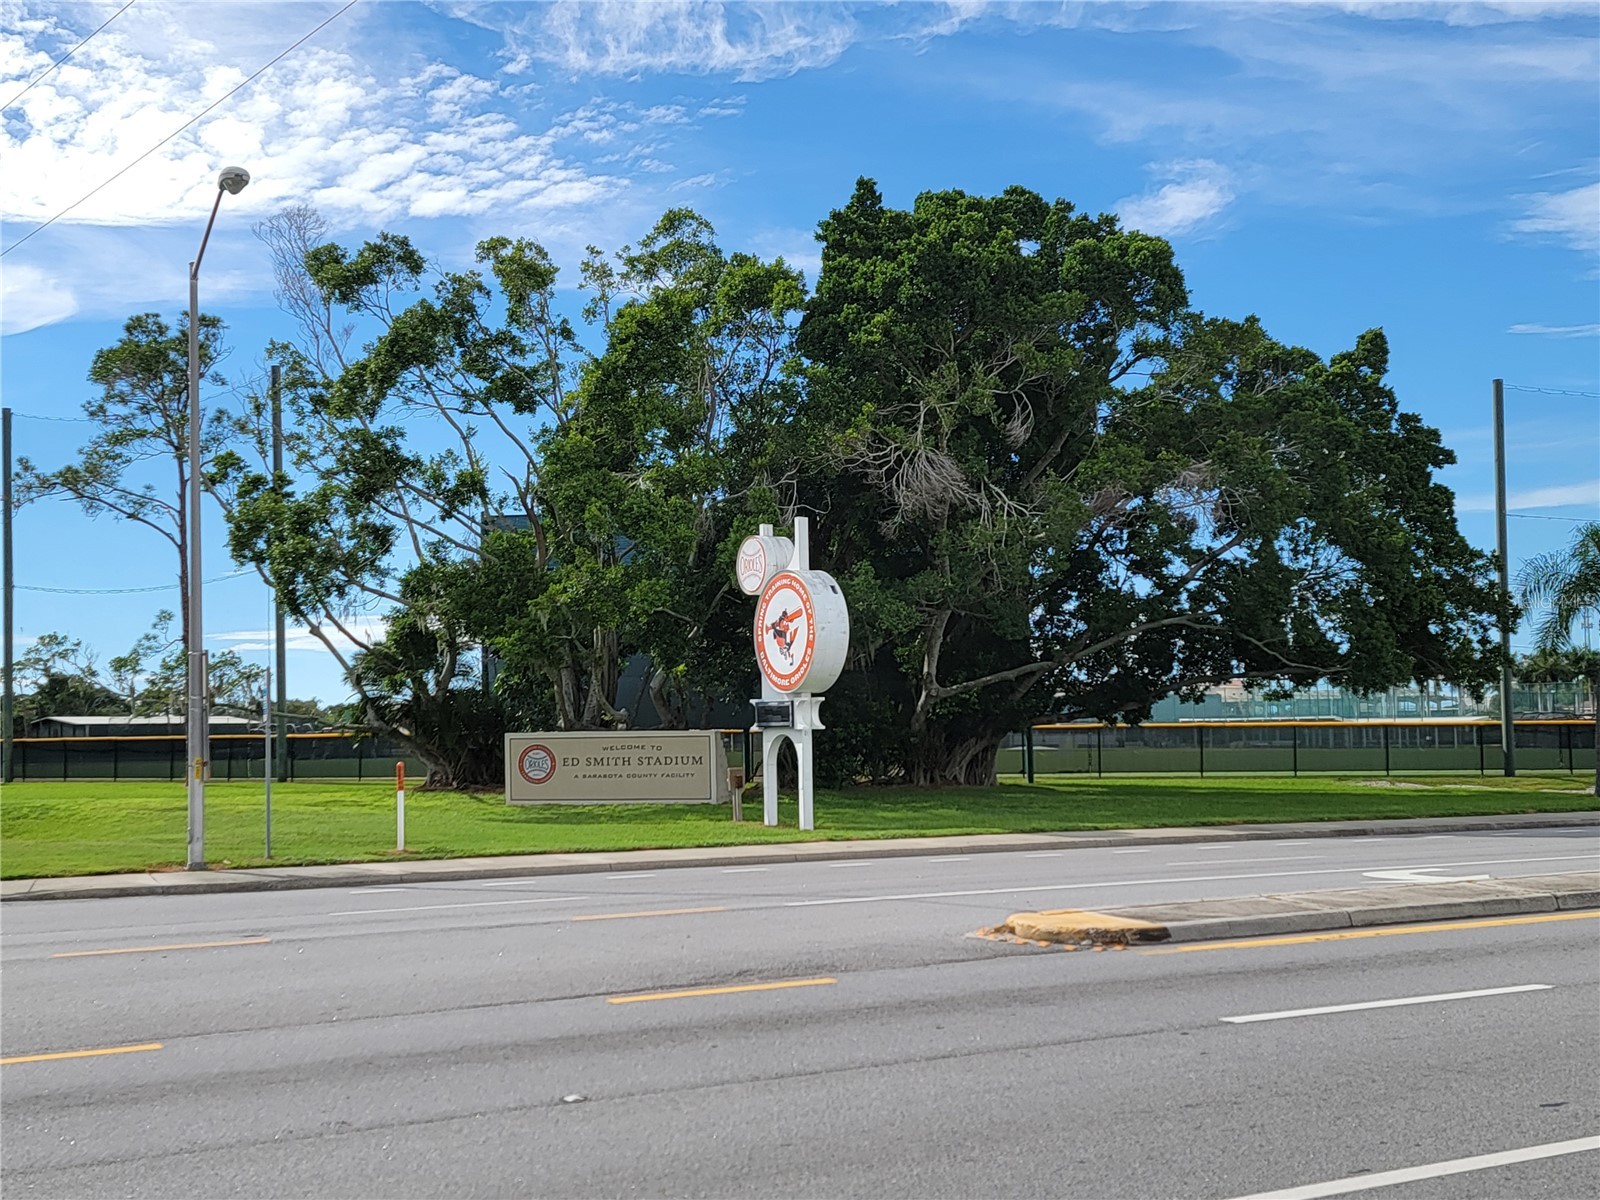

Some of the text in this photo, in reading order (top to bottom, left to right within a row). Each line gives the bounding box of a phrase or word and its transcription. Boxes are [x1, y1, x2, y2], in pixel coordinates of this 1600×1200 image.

[741, 554, 762, 575] ORIOLES
[758, 602, 767, 642] SPRING
[765, 579, 791, 600] TRAINING
[792, 580, 807, 602] HOME
[806, 602, 812, 614] OF
[760, 648, 811, 685] BALTIMORE ORIOLES
[525, 757, 549, 770] ORIOLES
[562, 755, 703, 766] ED SMITH STADIUM
